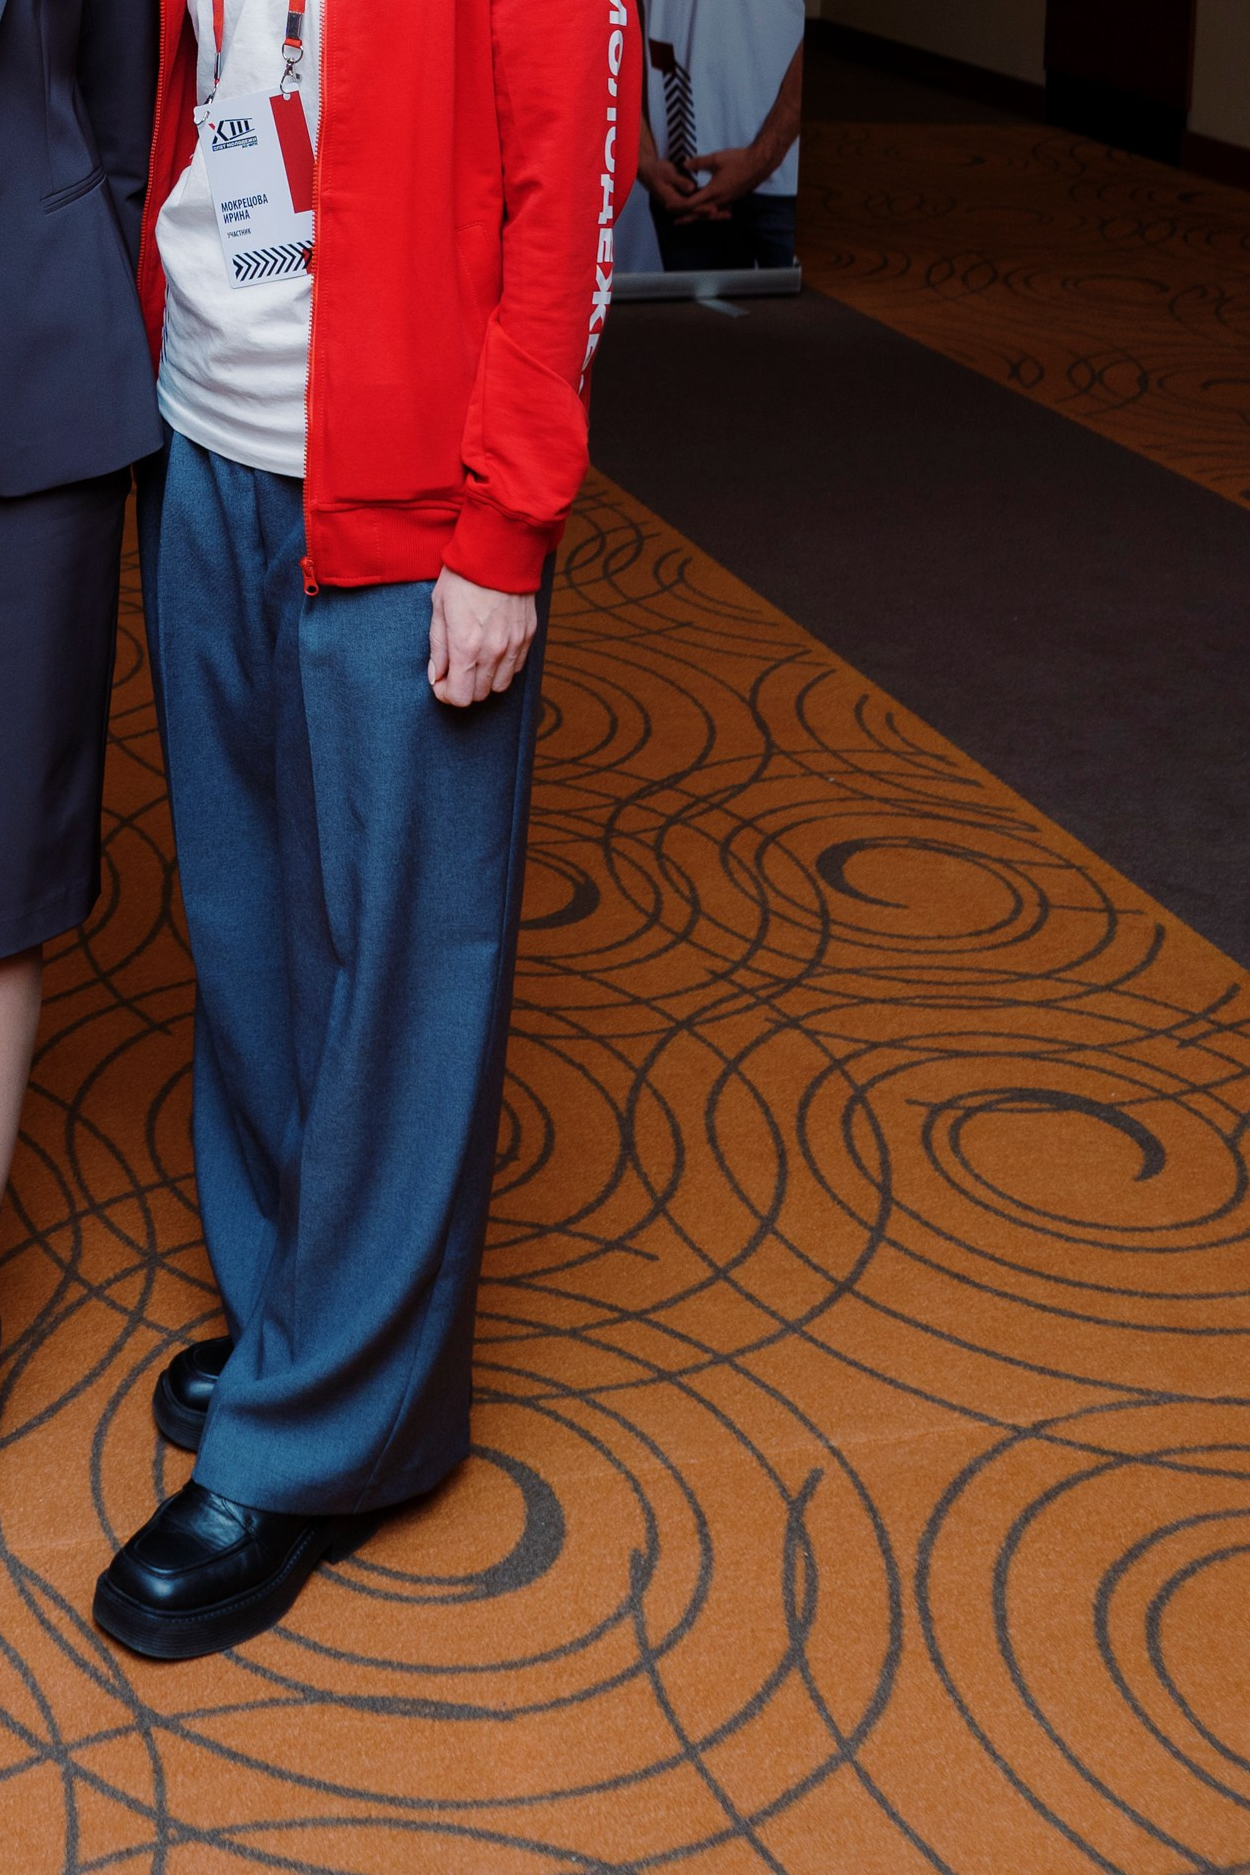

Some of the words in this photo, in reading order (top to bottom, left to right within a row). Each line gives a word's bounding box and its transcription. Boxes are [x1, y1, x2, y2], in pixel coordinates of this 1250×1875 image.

[221, 193, 269, 213] МОКРЕЦОВА
[223, 209, 251, 224] ИРИНА
[226, 228, 252, 238] УЧАСТНИК
